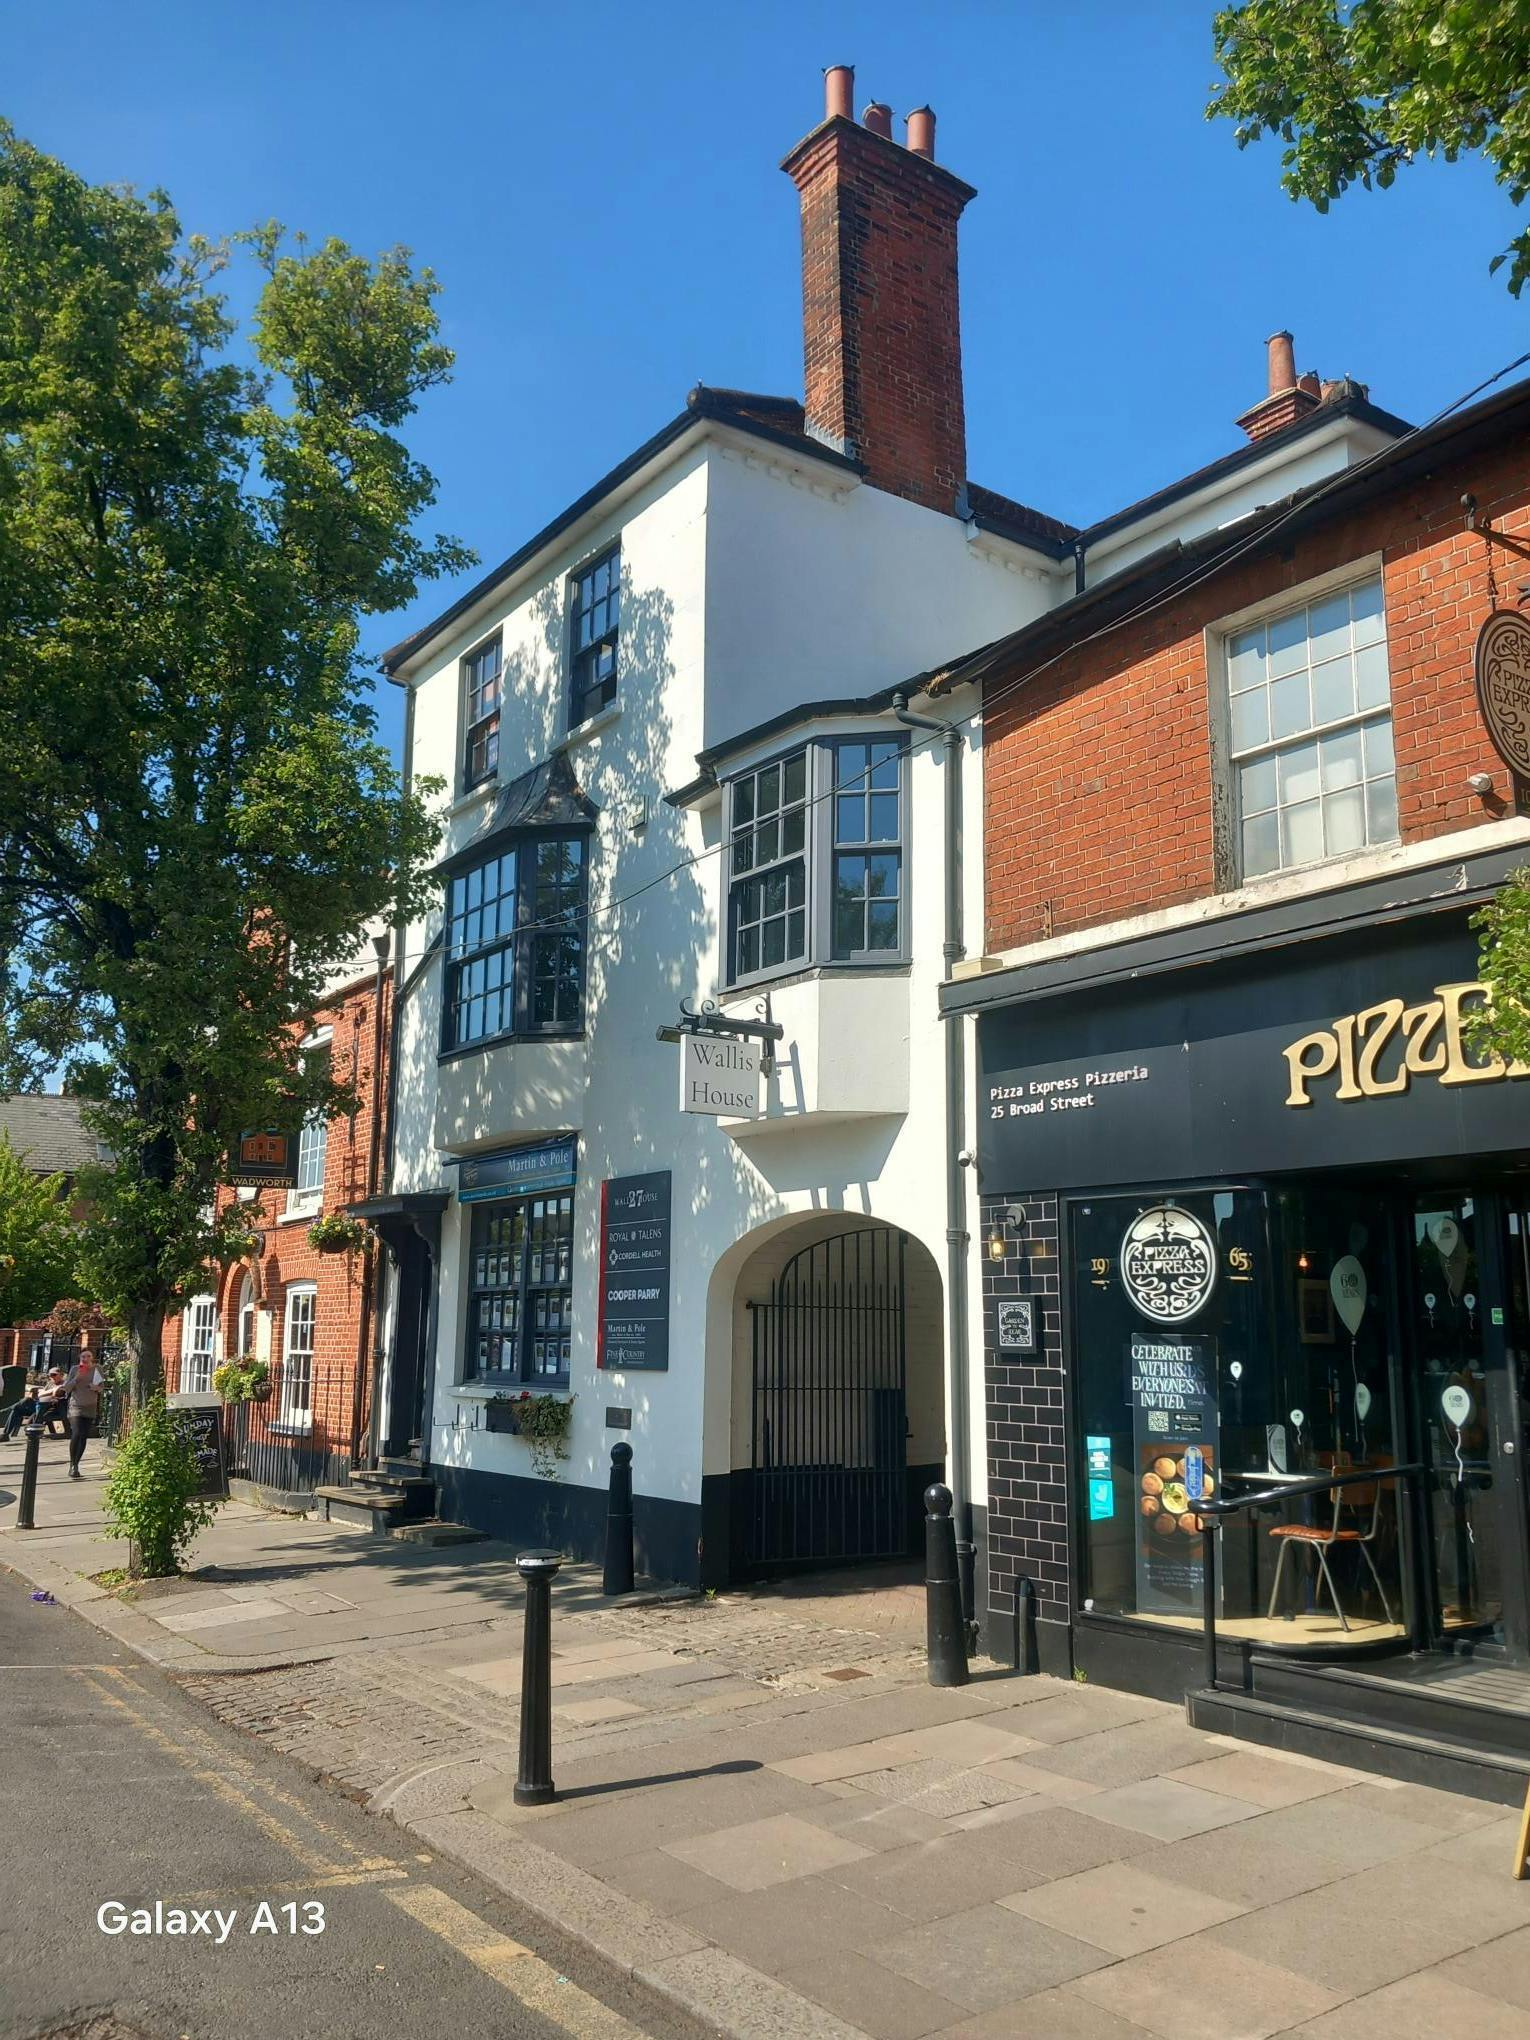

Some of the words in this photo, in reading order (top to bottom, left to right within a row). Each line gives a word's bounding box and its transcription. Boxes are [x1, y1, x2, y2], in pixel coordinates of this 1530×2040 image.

[693, 1043, 753, 1071] Wallis
[990, 1086, 1023, 1101] Pizza
[1029, 1077, 1079, 1095] Express
[1085, 1065, 1149, 1086] Pizzeria
[691, 1081, 754, 1108] House
[990, 1105, 1004, 1119] 25
[1010, 1099, 1044, 1116] Broad
[1050, 1093, 1094, 1111] Street
[508, 1159, 537, 1173] Martin
[540, 1156, 547, 1167] &
[550, 1149, 569, 1165] Pole
[231, 1177, 293, 1187] WADWORTH
[628, 1189, 644, 1208] 27
[609, 1231, 629, 1242] ROYAL
[638, 1228, 662, 1240] TALENS
[641, 1249, 662, 1258] HEALTH
[1144, 1246, 1191, 1260] PIZZA
[1131, 1259, 1205, 1275] EXPRESS
[608, 1289, 637, 1301] COOPER
[637, 1288, 660, 1300] PARRY
[1131, 1344, 1193, 1361] CELEBRATE
[1138, 1361, 1168, 1376] WITH
[1131, 1376, 1195, 1394] EVERYONE'S
[1140, 1392, 1186, 1409] INVITED.
